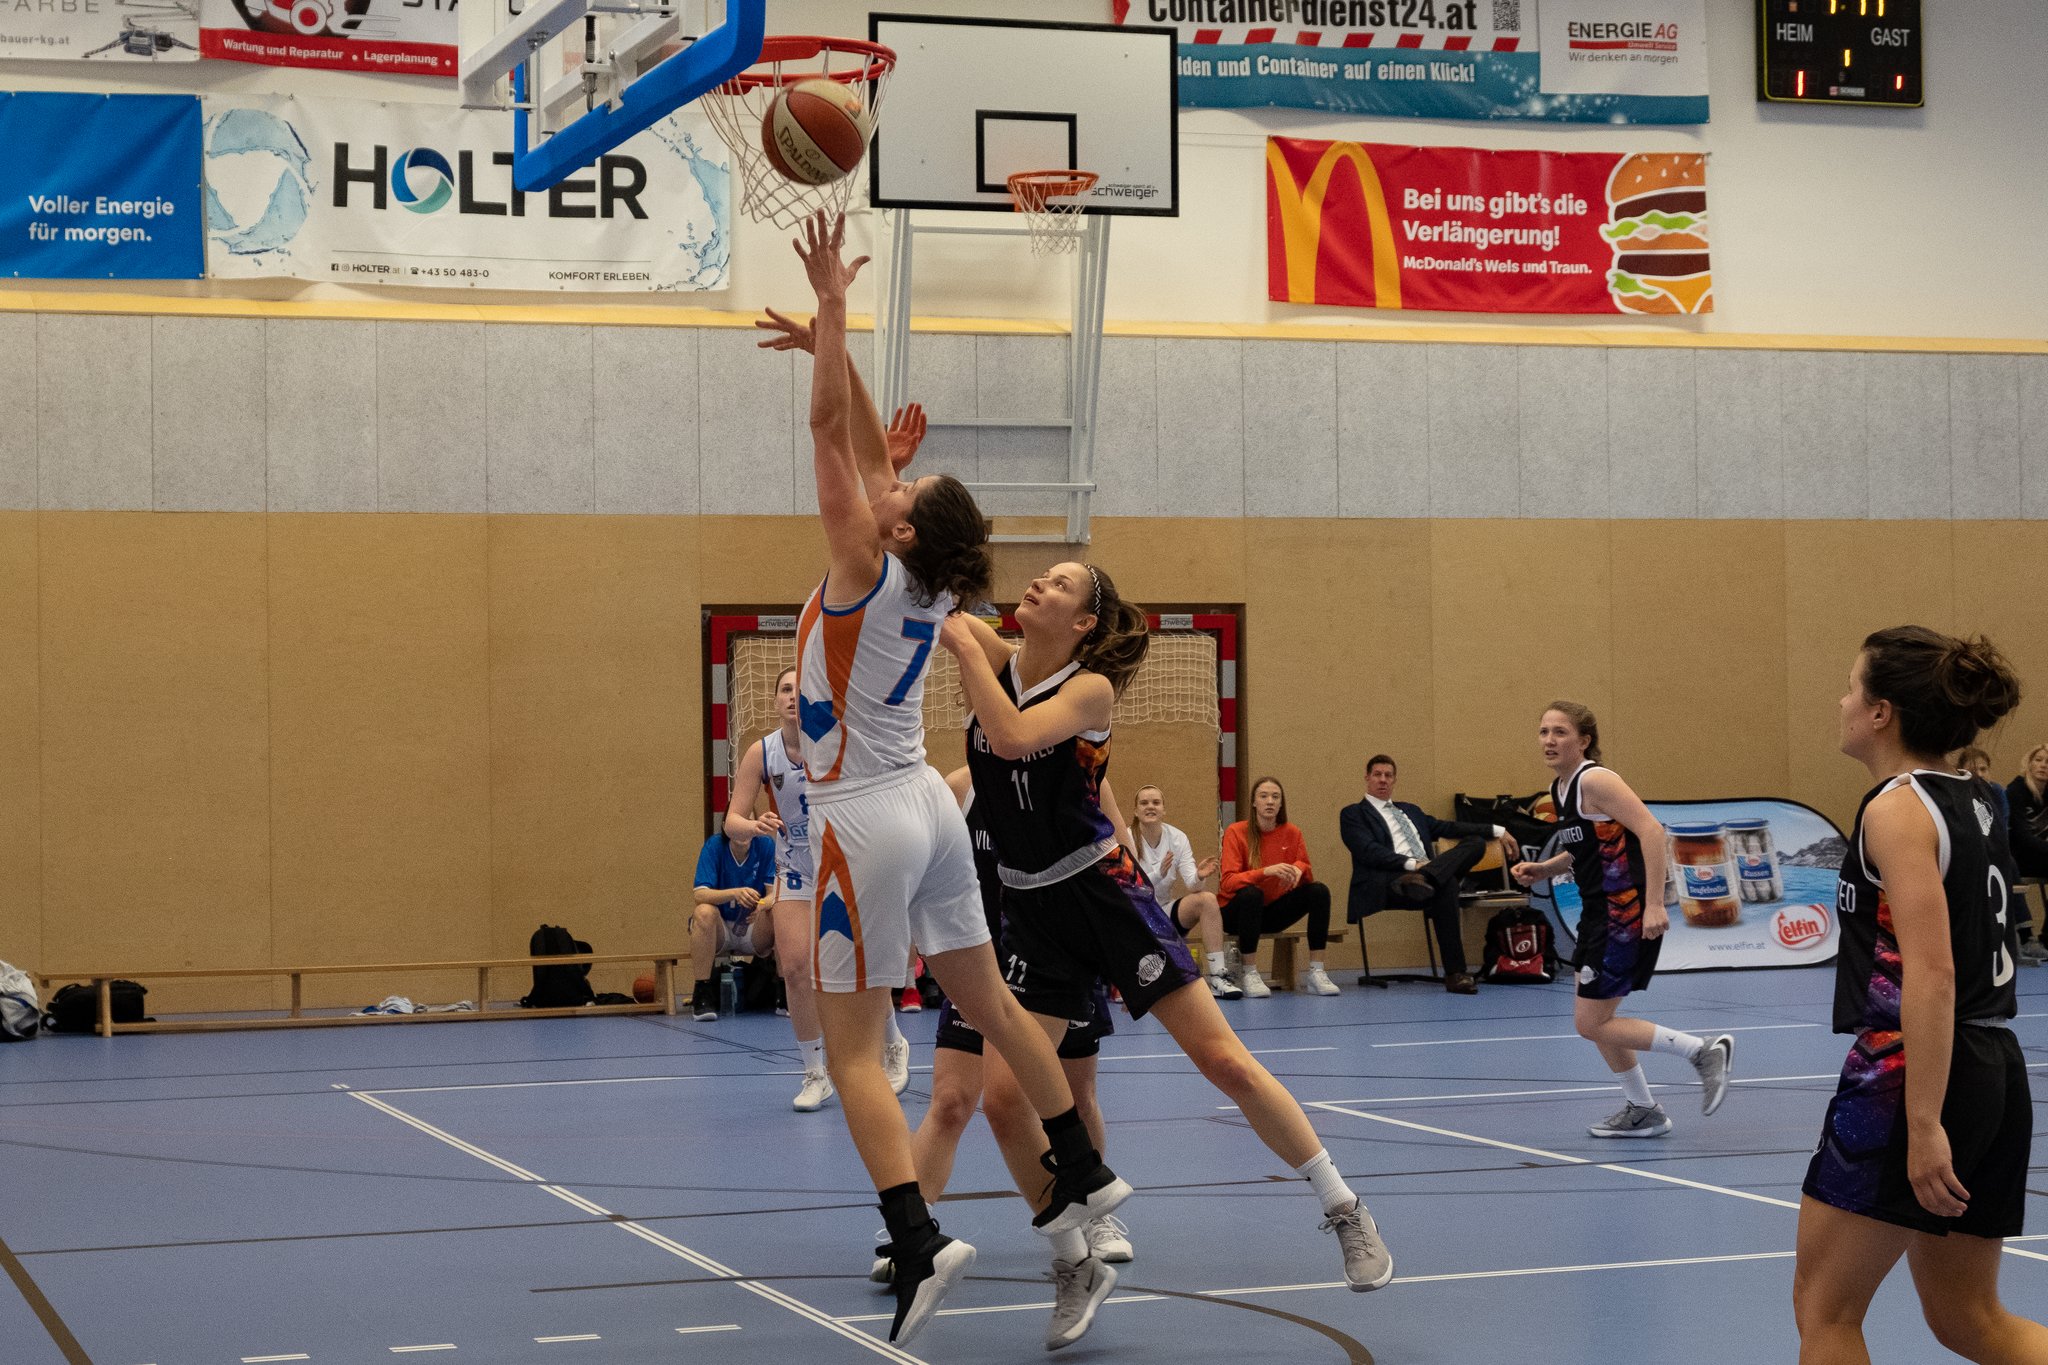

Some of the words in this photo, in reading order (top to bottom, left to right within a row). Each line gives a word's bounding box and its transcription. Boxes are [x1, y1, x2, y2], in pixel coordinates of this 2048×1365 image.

[0, 0, 99, 13] ARBE
[1568, 21, 1652, 38] ENERGIE
[1654, 23, 1678, 40] AG
[1776, 23, 1813, 42] HEIM
[1871, 27, 1910, 47] GAST
[223, 38, 265, 55] Wartung
[267, 43, 286, 55] und
[289, 46, 343, 60] Reparatur
[364, 50, 438, 65] Lagerplanung
[1569, 53, 1586, 62] Wir
[1588, 52, 1627, 62] denken
[1629, 54, 1641, 62] an
[1644, 54, 1678, 65] morgen
[1217, 56, 1250, 76] und
[1257, 55, 1338, 79] Container
[1344, 60, 1371, 80] auf
[1378, 60, 1426, 81] einen
[1430, 62, 1475, 82] Klick!
[333, 142, 648, 220] HOLTER
[1091, 186, 1158, 199] schweiger
[29, 195, 89, 214] Voller
[95, 196, 174, 219] Energie
[1404, 188, 1441, 210] Bei
[1447, 194, 1485, 212] uns
[1489, 191, 1550, 219] gibt's
[1554, 193, 1587, 215] die
[29, 221, 58, 240] für
[65, 227, 152, 245] morgen.
[1402, 219, 1560, 251] Verlängerung!
[421, 267, 440, 276] +43
[443, 268, 456, 277] 50
[460, 269, 489, 277] 483-0
[548, 271, 600, 280] KOMFORT
[1404, 255, 1482, 272] McDonald's
[1484, 259, 1519, 273] Wels
[1522, 260, 1547, 273] und
[1549, 260, 1592, 274] Traun.
[885, 617, 935, 706] 7
[1011, 769, 1033, 811] 11
[1783, 918, 1819, 939] elfin
[1987, 864, 2014, 987] 3
[1709, 941, 1765, 951] www.elfin.at
